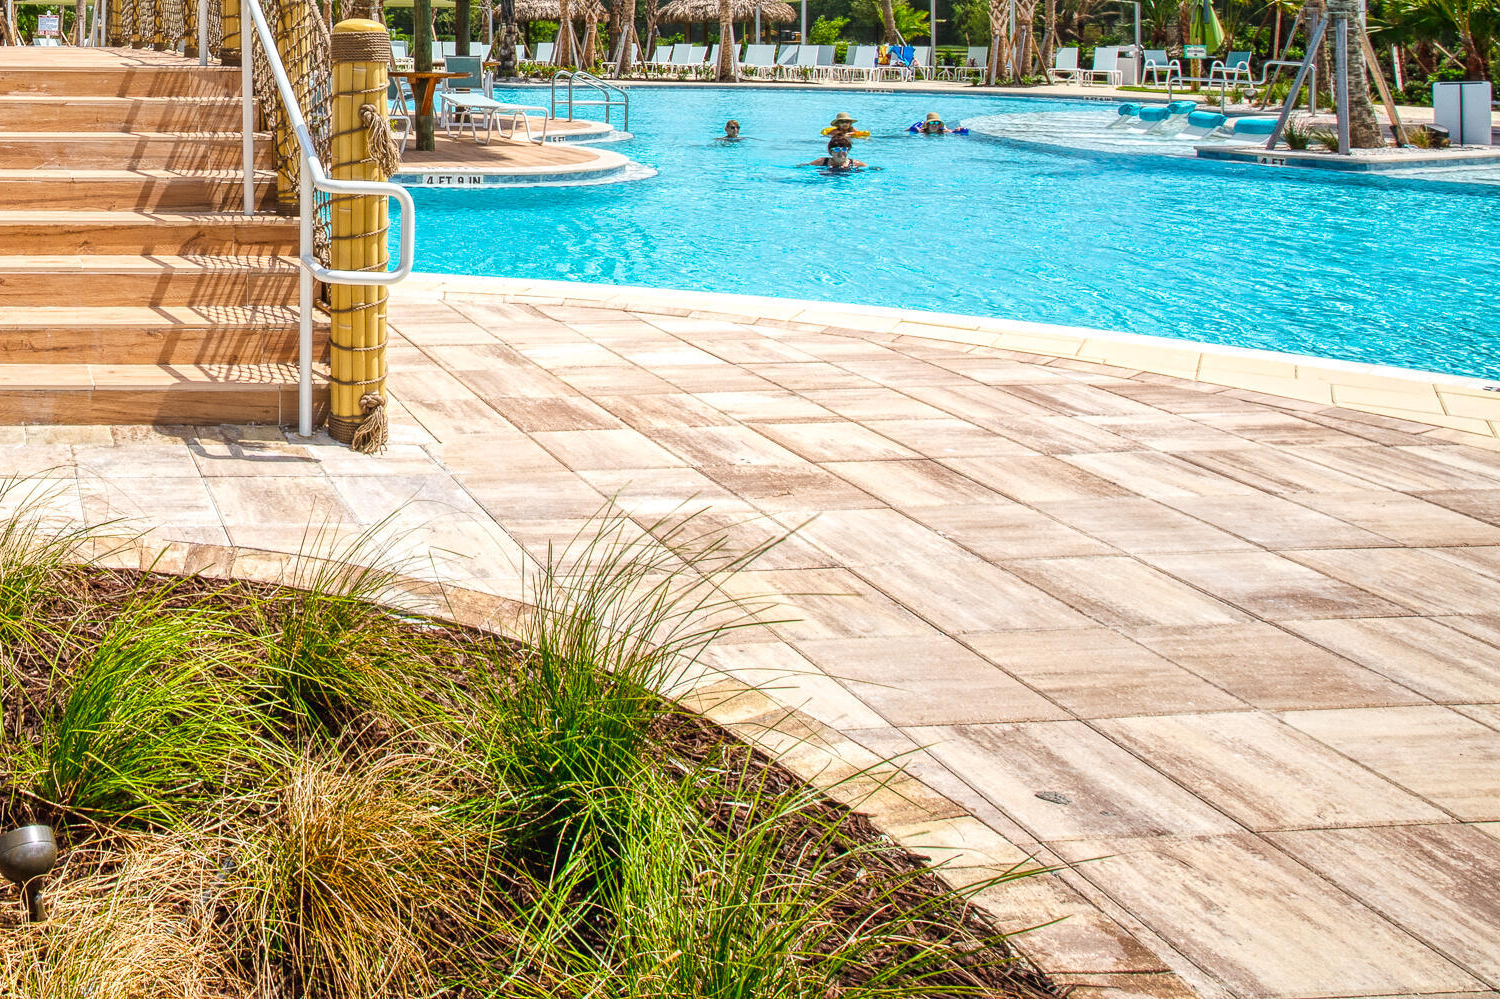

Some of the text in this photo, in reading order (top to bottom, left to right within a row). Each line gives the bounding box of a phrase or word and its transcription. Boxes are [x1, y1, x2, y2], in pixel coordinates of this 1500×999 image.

[426, 176, 434, 184] 4
[438, 176, 453, 184] FT
[468, 176, 481, 184] IN
